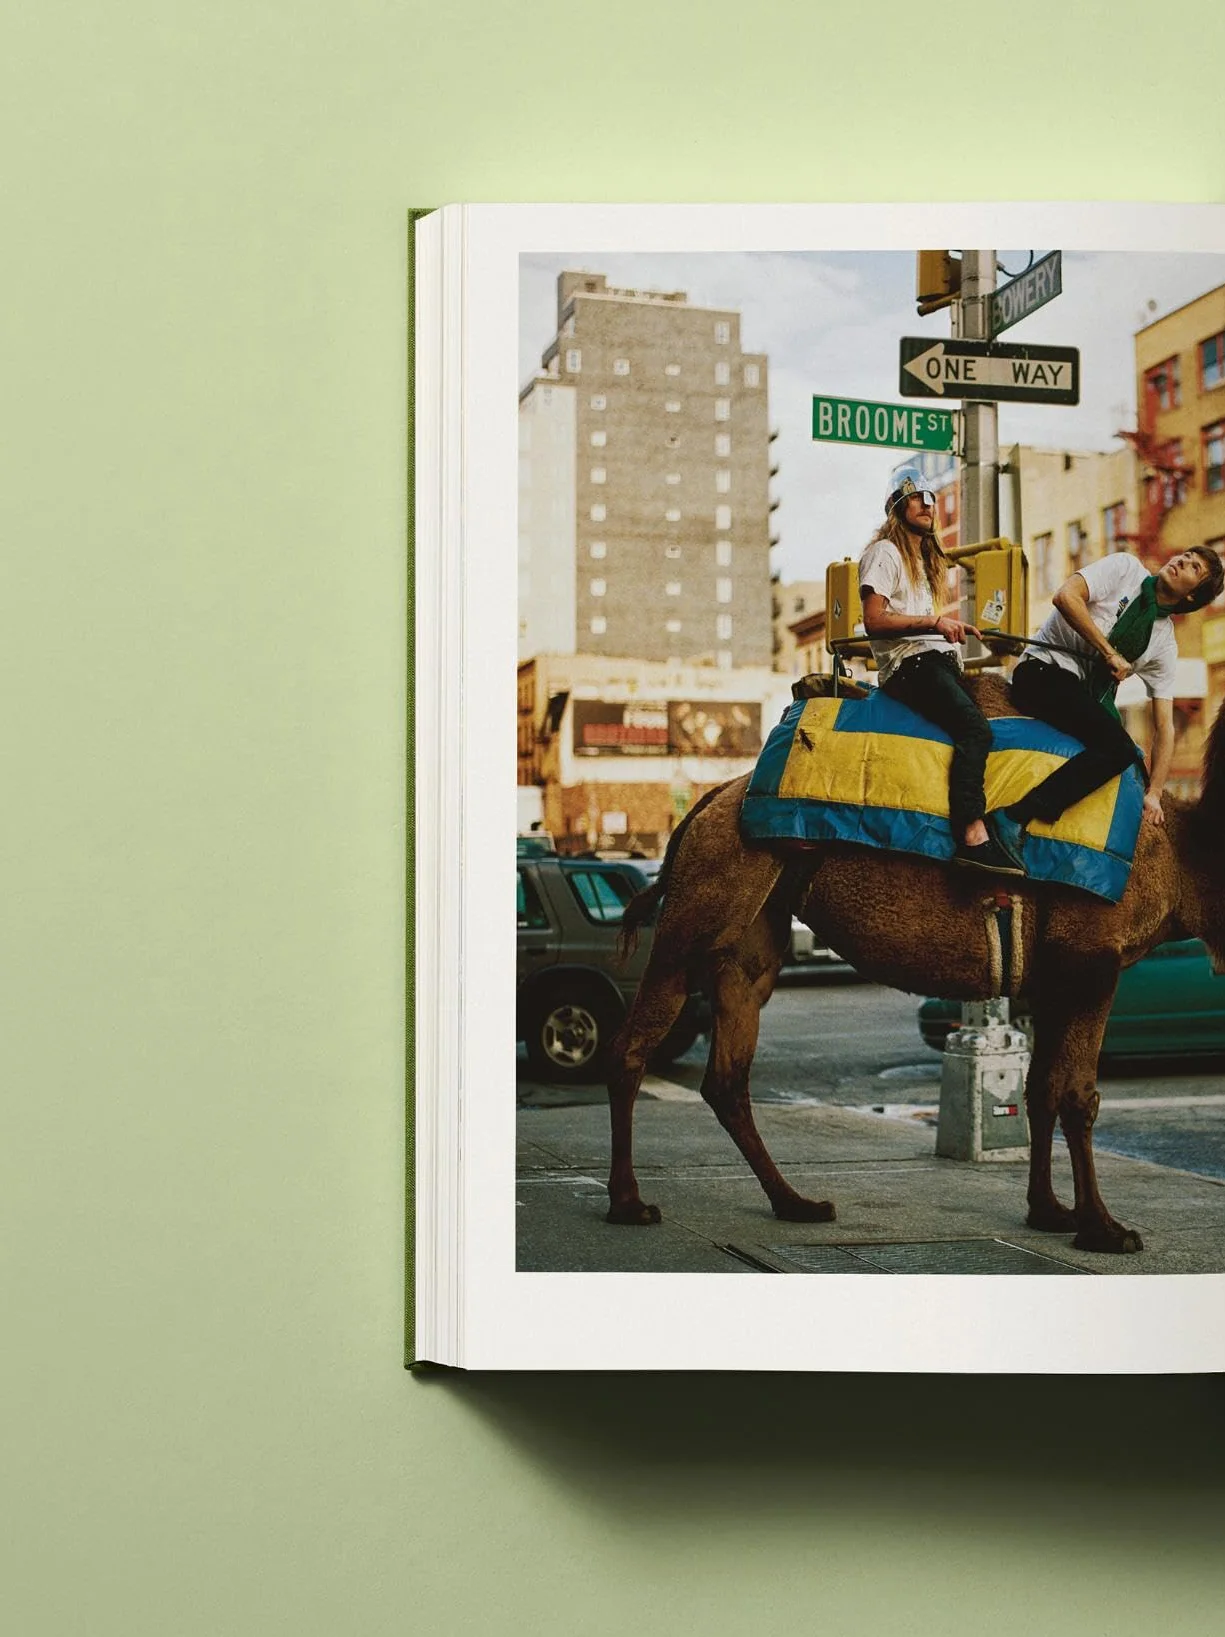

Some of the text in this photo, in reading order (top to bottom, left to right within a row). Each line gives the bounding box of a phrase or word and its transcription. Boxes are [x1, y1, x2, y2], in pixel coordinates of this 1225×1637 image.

[993, 255, 1058, 330] BOWERY
[926, 357, 1064, 386] ONE WAY
[818, 401, 949, 445] BROOME ST
